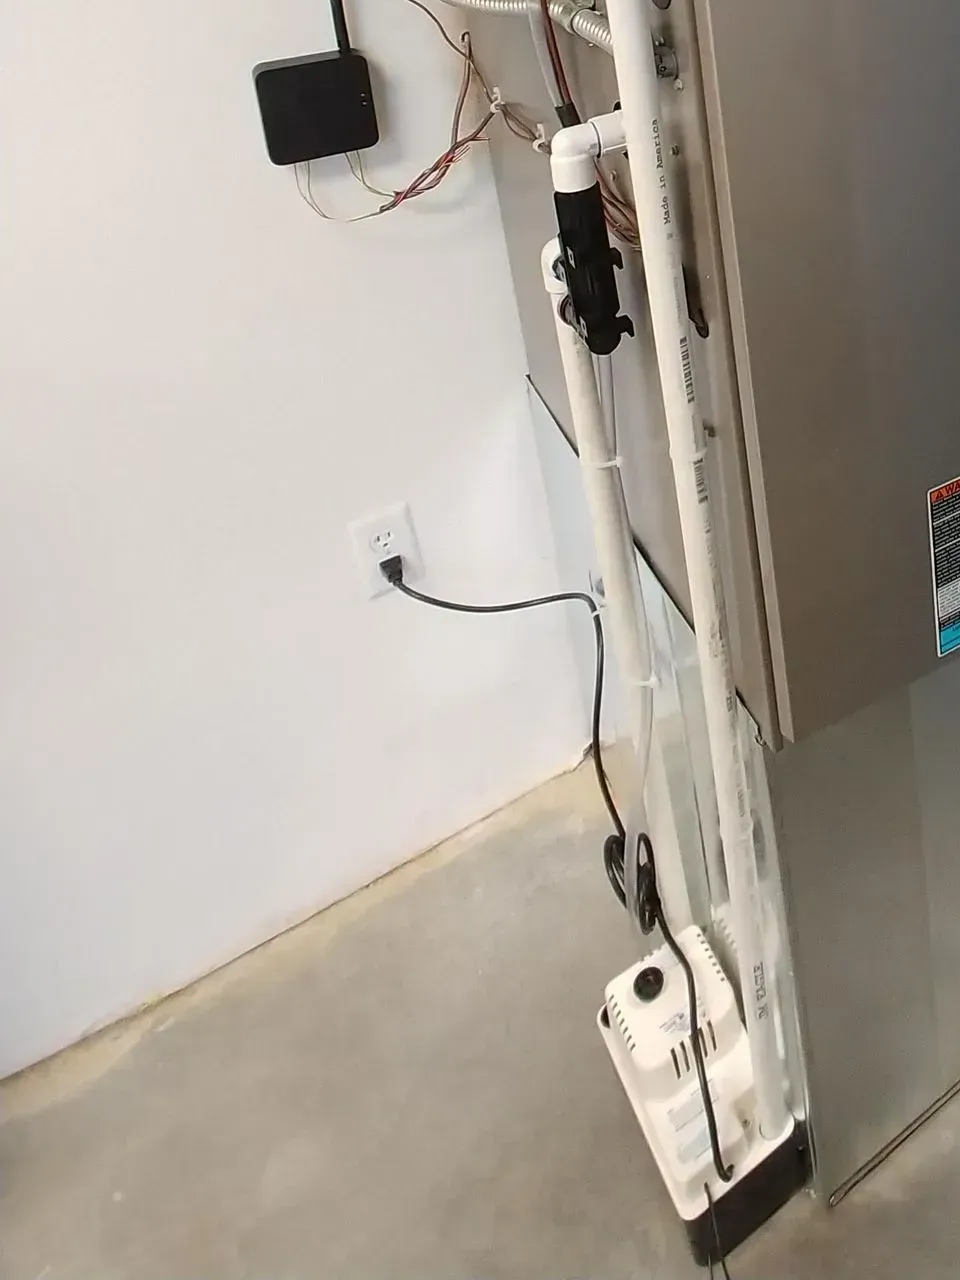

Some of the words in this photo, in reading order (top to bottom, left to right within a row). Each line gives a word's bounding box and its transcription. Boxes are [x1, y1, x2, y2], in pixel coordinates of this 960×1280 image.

[651, 119, 664, 169] America
[659, 174, 668, 189] in
[661, 195, 672, 225] Made
